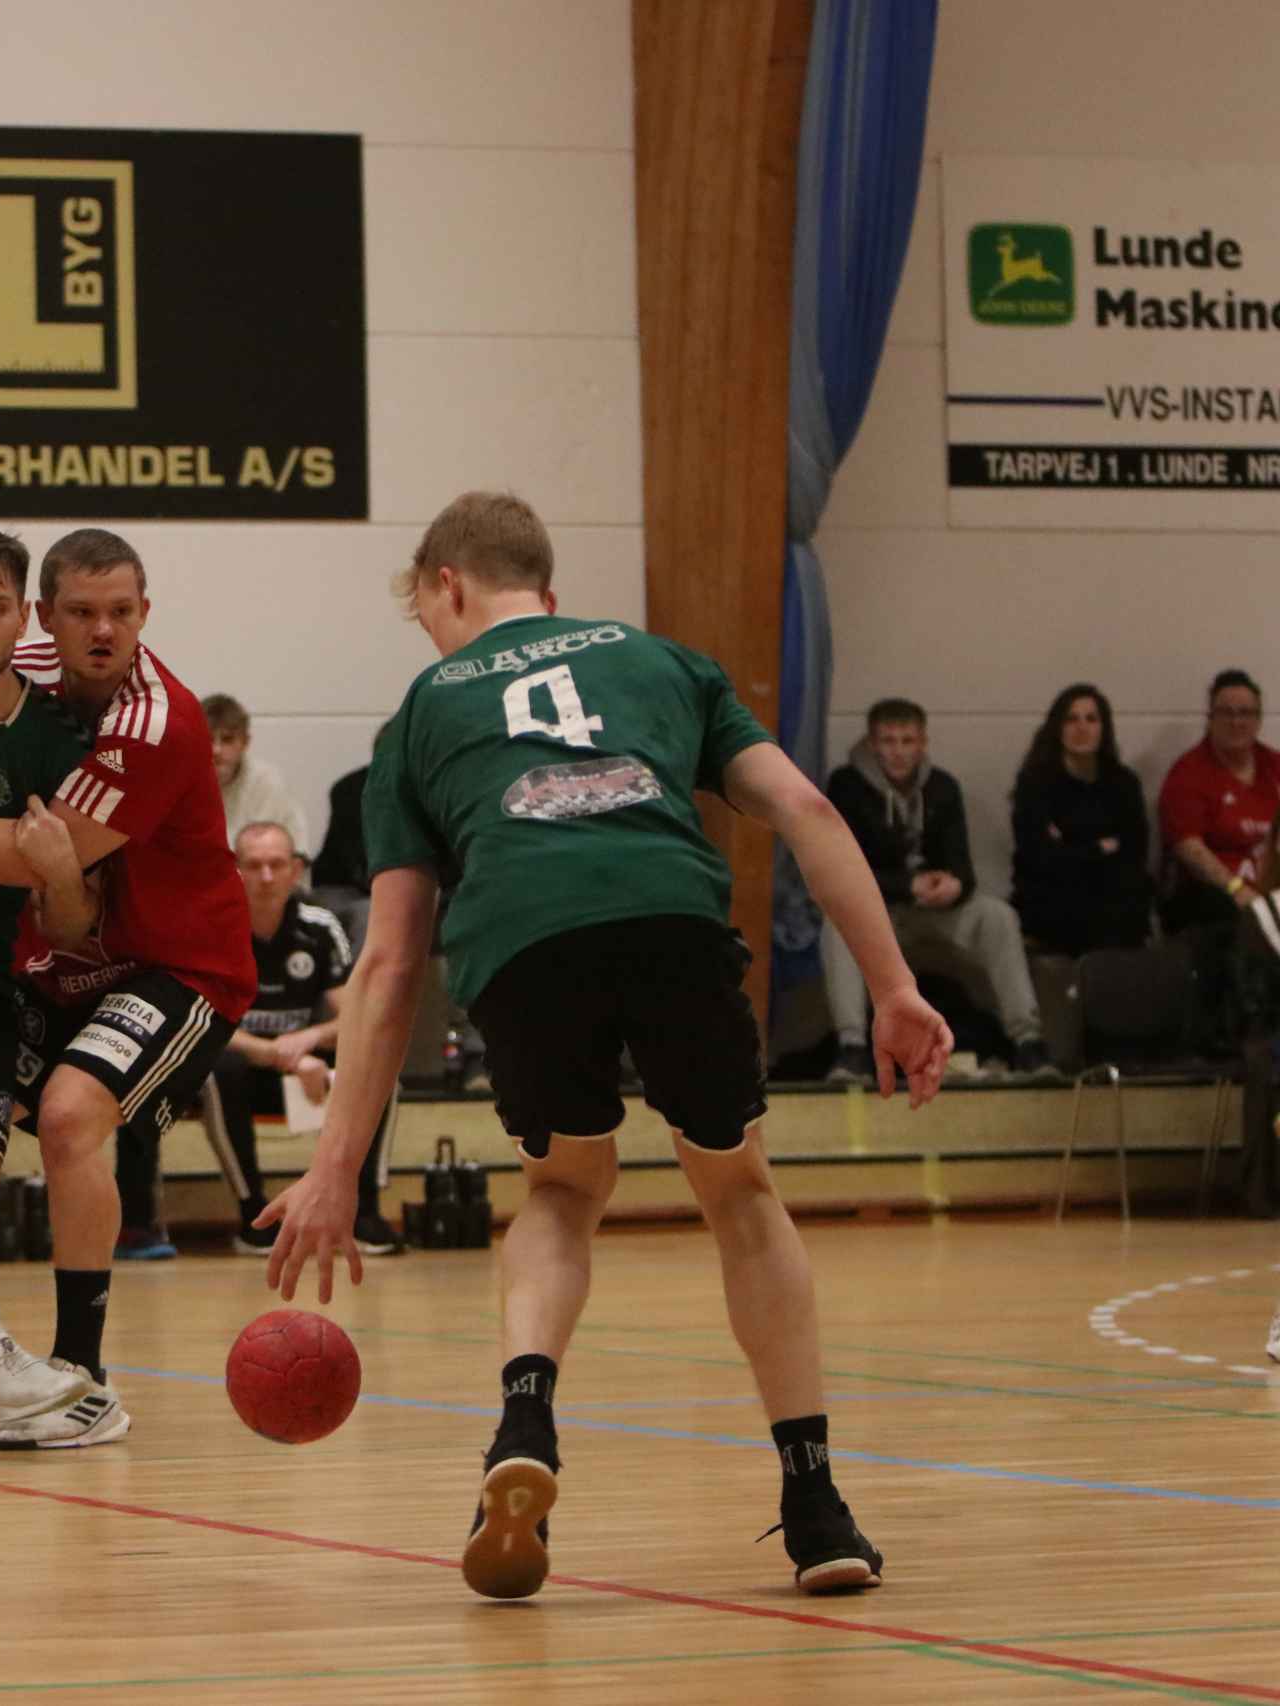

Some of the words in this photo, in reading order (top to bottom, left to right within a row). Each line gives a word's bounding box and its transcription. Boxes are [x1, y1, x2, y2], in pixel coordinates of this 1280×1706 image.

[63, 196, 105, 307] BYG
[1093, 226, 1242, 269] Lunde
[1106, 385, 1280, 423] VVS-INSTA
[237, 446, 335, 491] A/S
[986, 452, 1101, 482] TARPVEJ
[1141, 454, 1227, 484] LUNDE
[489, 628, 627, 673] ARCO
[502, 664, 604, 749] 4
